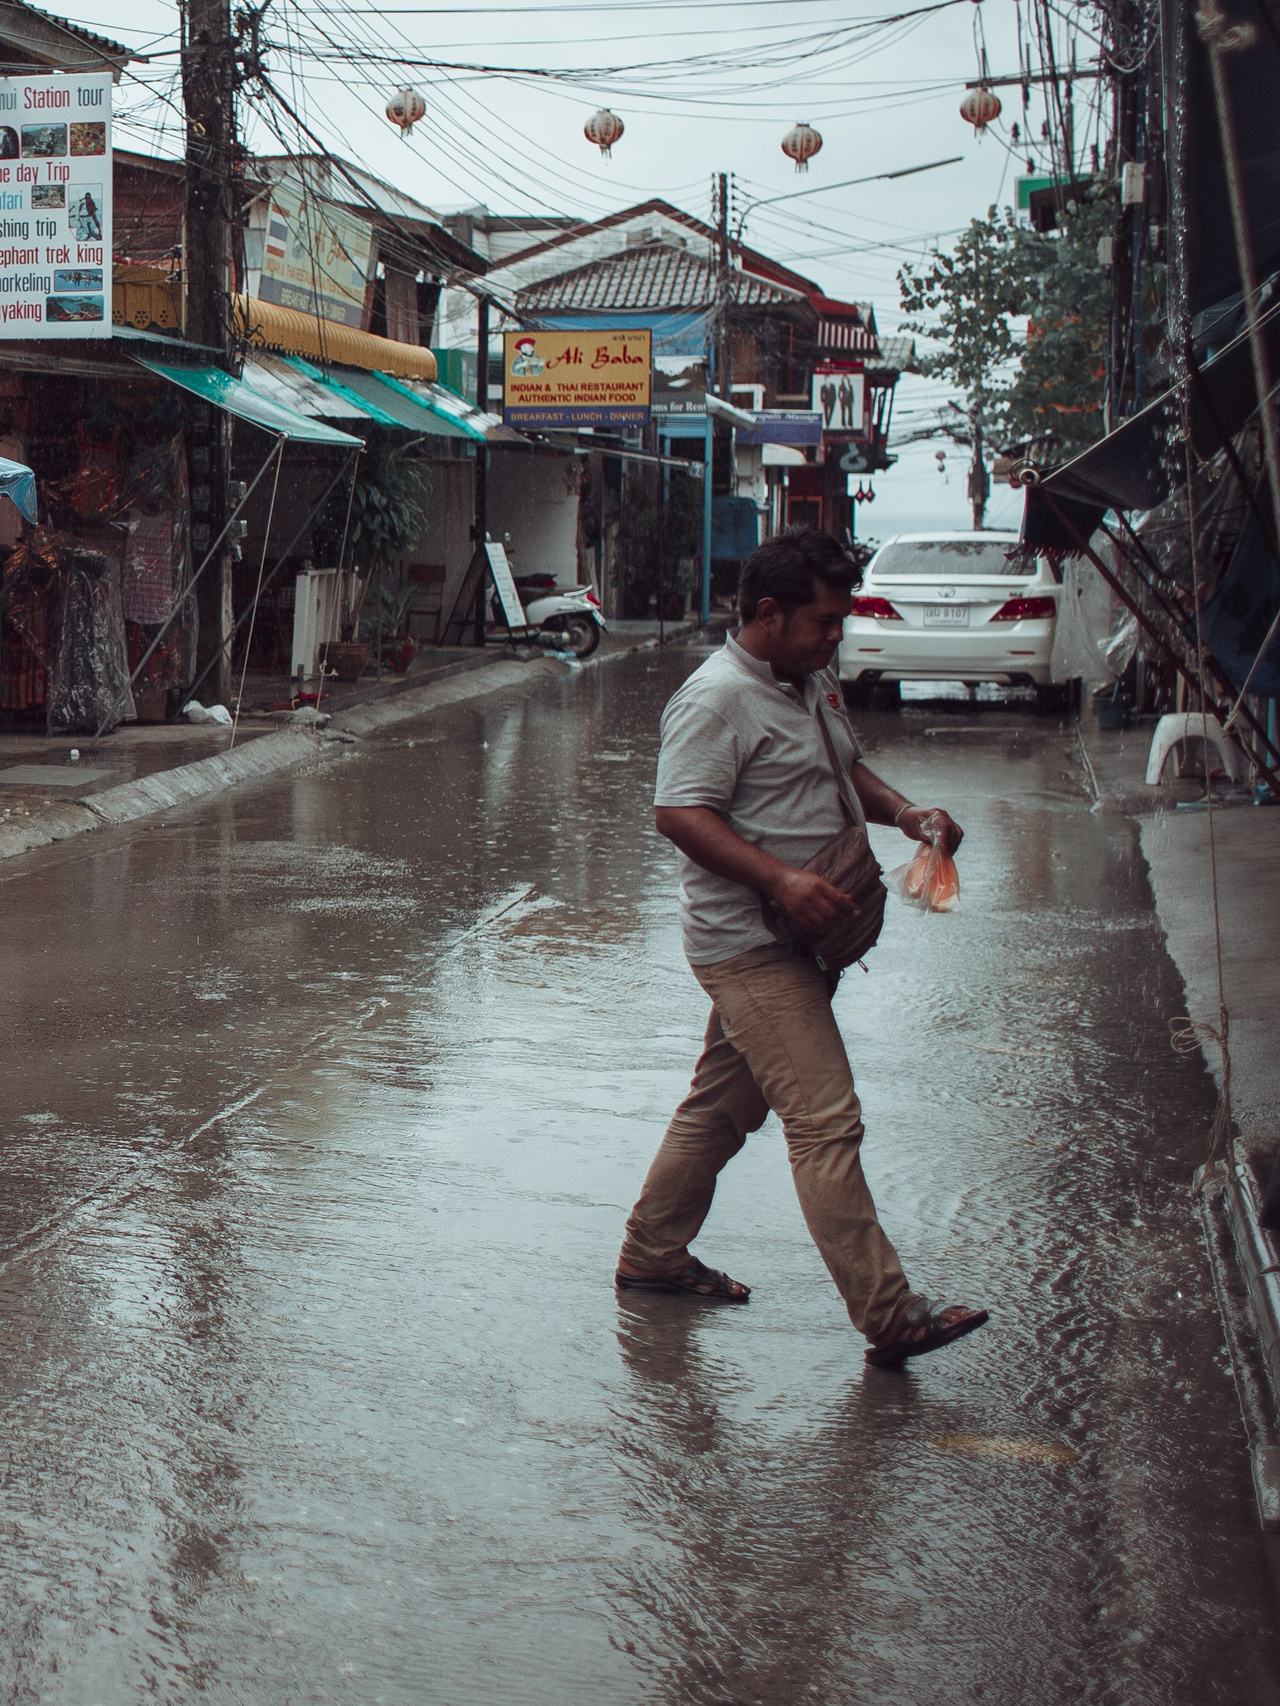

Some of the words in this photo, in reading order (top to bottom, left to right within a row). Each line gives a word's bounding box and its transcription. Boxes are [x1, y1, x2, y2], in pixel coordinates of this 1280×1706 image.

[24, 86, 70, 110] Station
[77, 85, 104, 107] tour
[16, 162, 39, 186] day
[46, 161, 70, 184] Trip
[36, 218, 57, 239] trip
[46, 245, 70, 264] trek
[77, 243, 103, 267] king
[546, 346, 583, 369] Ali
[591, 345, 643, 369] Baba
[510, 383, 542, 392] INDIAN
[544, 383, 551, 391] &
[556, 383, 579, 391] THAI
[581, 382, 645, 391] RESTAURANT
[518, 394, 572, 403] AUTHENTIC
[574, 393, 606, 402] INDIAN
[609, 393, 636, 402] FOOD
[669, 400, 684, 412] for
[510, 412, 564, 421] BREAKFAST
[571, 412, 603, 421] LUNCH
[610, 411, 644, 421] DINNER
